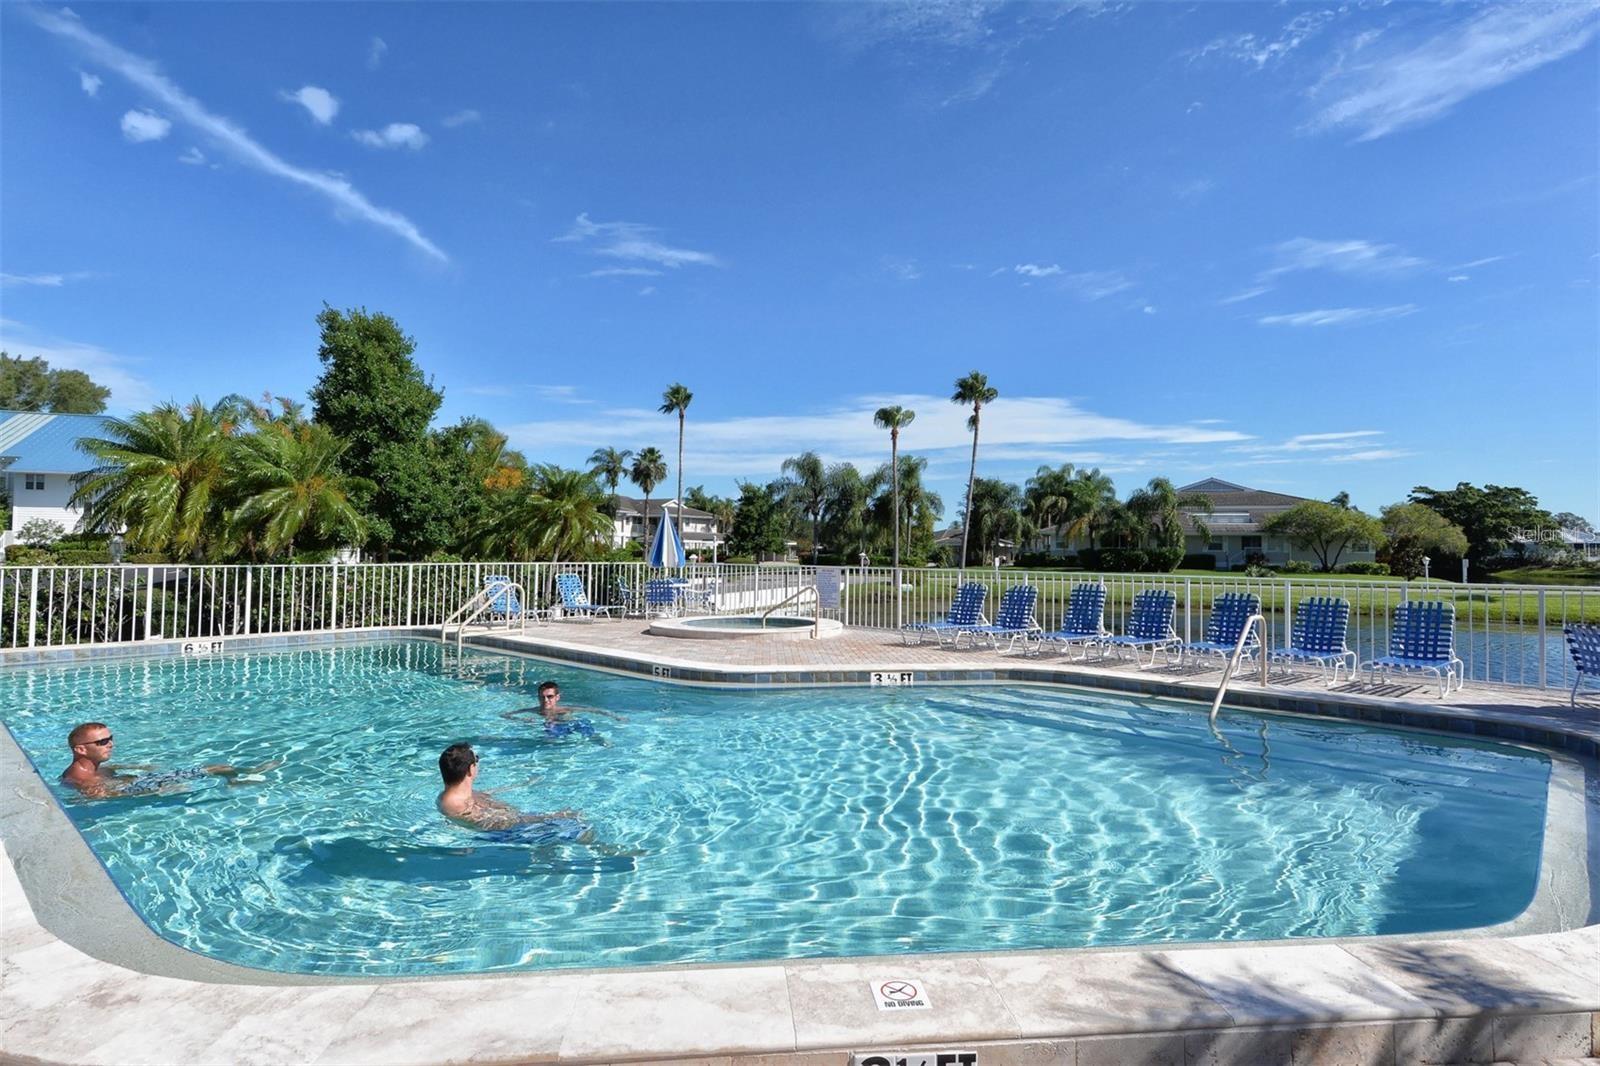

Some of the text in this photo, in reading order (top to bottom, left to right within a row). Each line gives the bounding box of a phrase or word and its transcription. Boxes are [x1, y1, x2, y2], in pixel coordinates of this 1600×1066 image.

[184, 643, 193, 653] 6
[211, 641, 222, 653] FT
[654, 666, 670, 678] 5 FT
[874, 673, 882, 682] 3
[900, 673, 912, 682] FT
